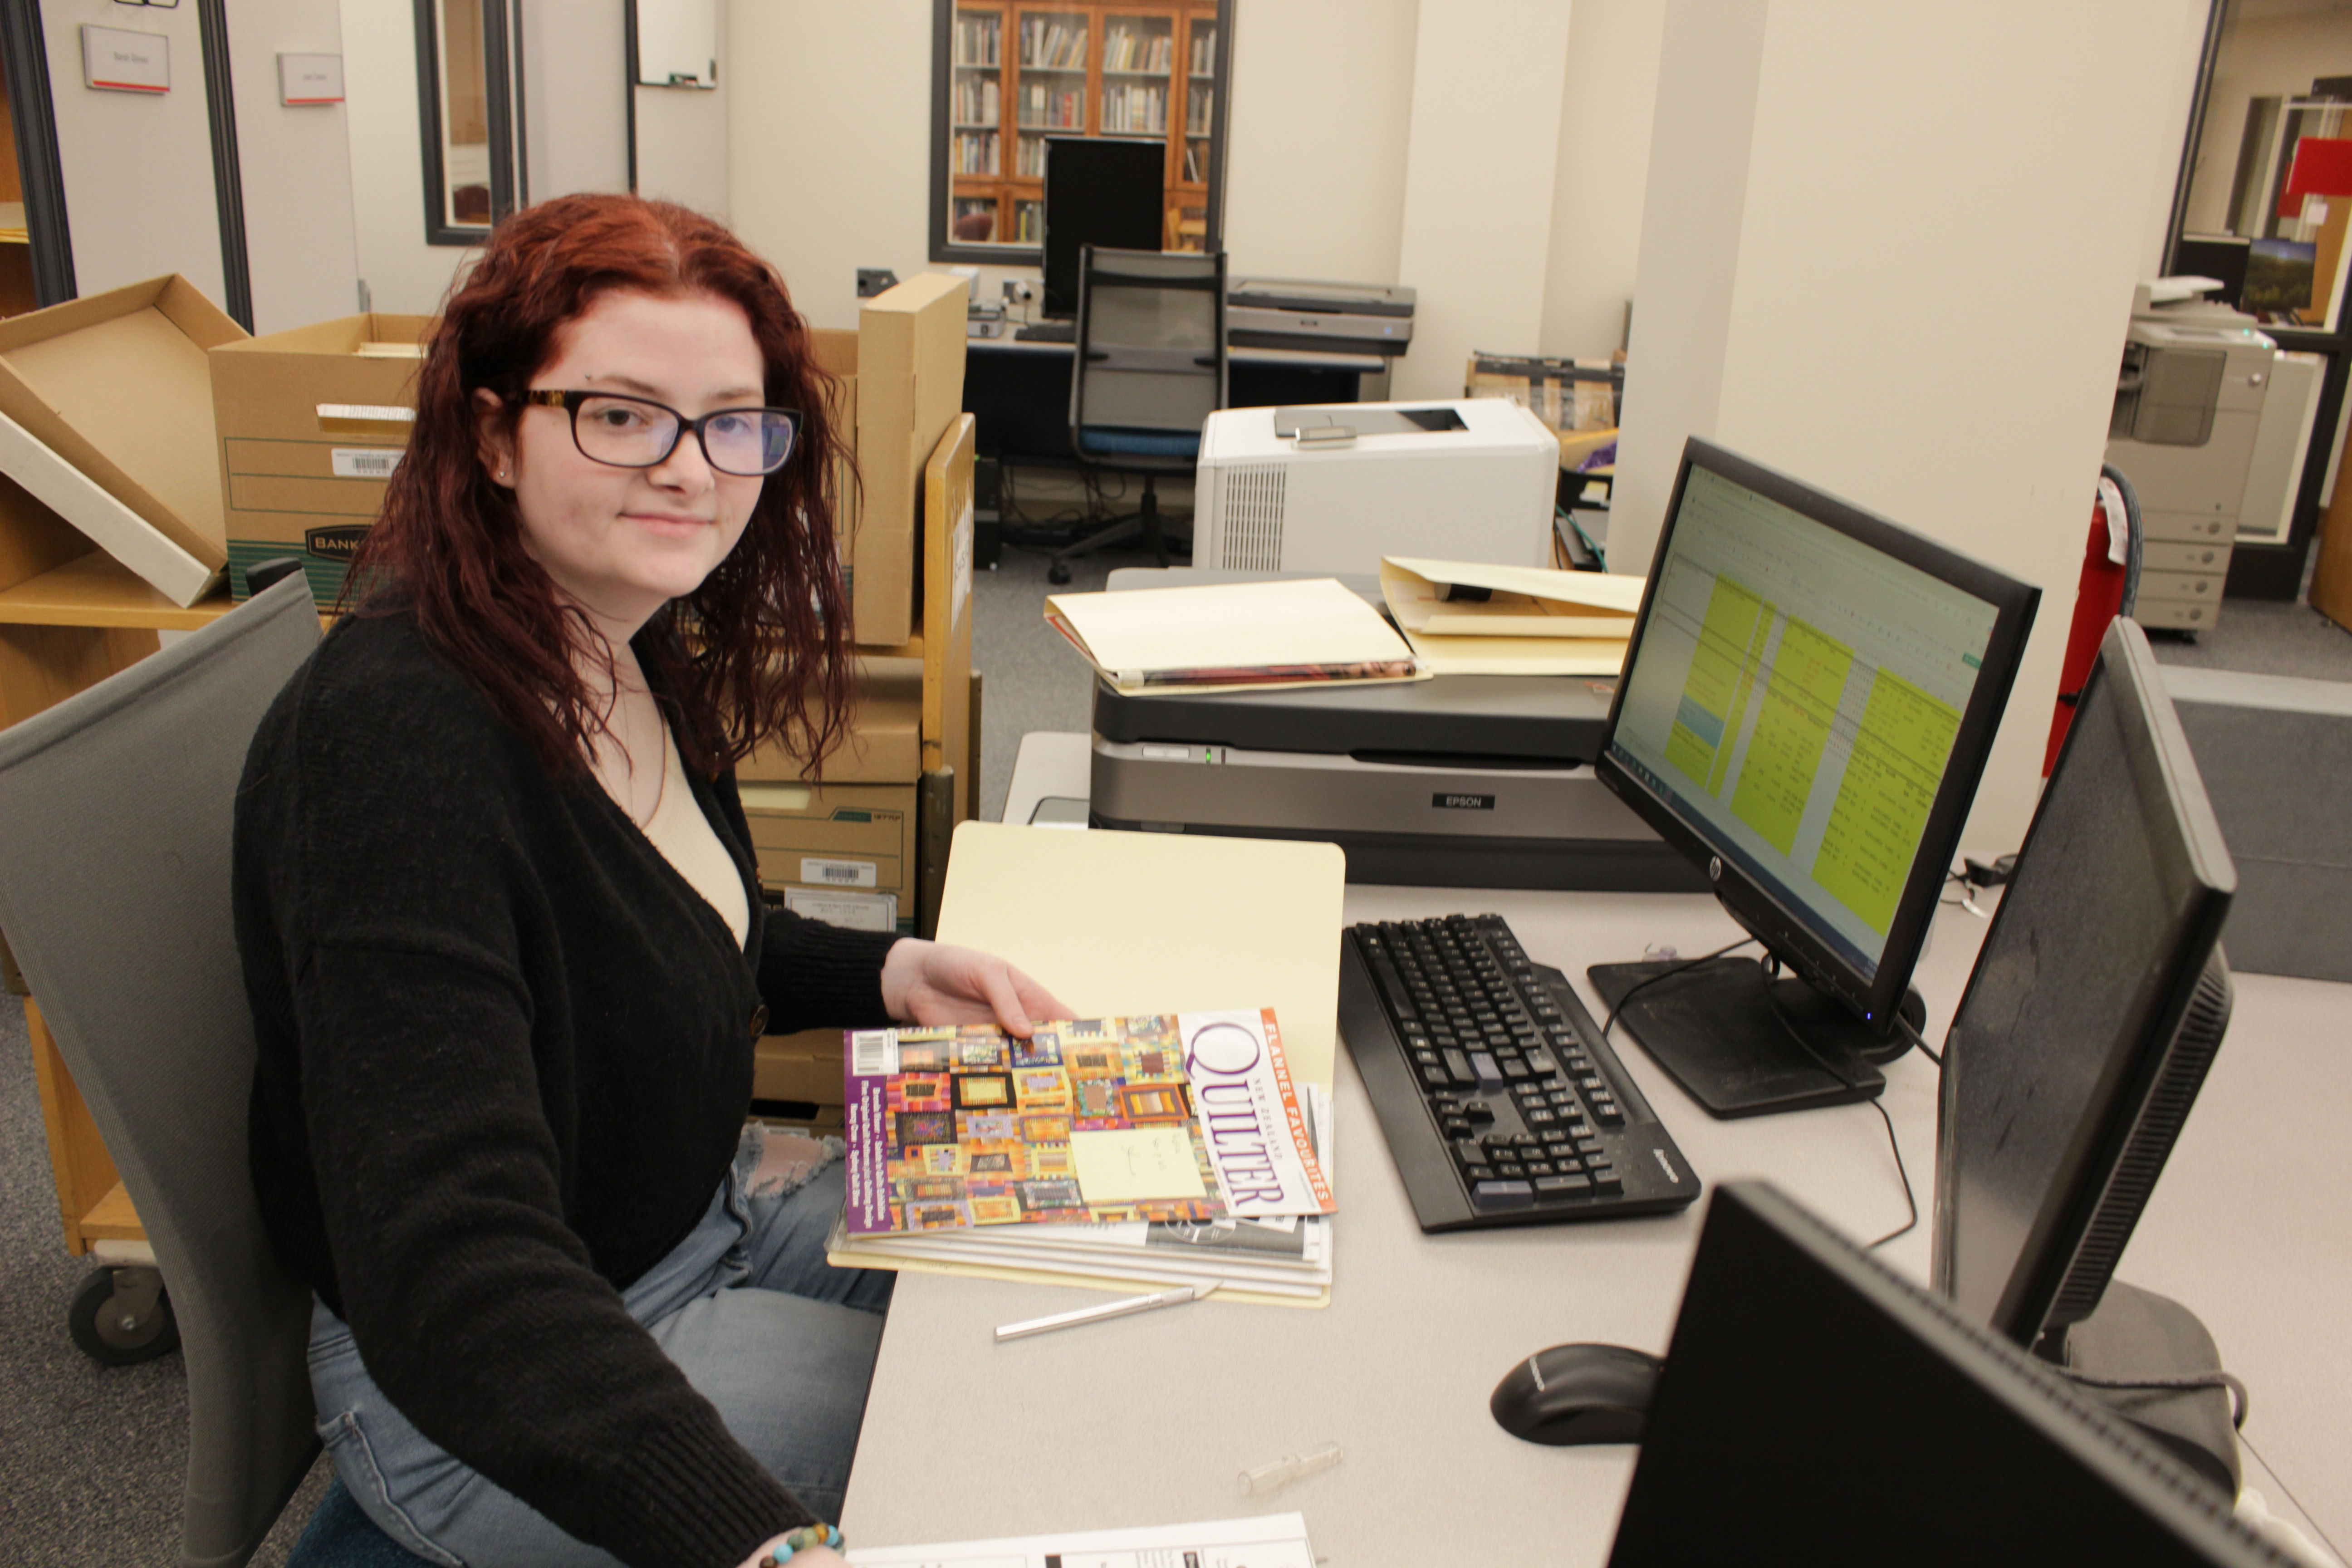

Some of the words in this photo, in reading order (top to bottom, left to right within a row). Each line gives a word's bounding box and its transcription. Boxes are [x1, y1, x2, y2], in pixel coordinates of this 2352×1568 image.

[1446, 796, 1481, 808] EPSON
[861, 1080, 869, 1096] Five
[872, 1087, 881, 1112] Brenda
[849, 1103, 858, 1124] Nancy
[860, 1096, 870, 1121] Original
[1185, 1023, 1285, 1207] QUILTER
[1252, 1078, 1266, 1102] NEW
[1261, 1107, 1283, 1161] ZEALAND
[1264, 1023, 1293, 1102] FLANNEL
[1286, 1107, 1330, 1201] FAVOURITES
[850, 1124, 858, 1142] Crow
[862, 1122, 871, 1138] Quilt
[873, 1112, 882, 1133] Visser
[850, 1150, 859, 1173] Sydney
[863, 1139, 872, 1166] Patterns
[1653, 1148, 1679, 1184] lenovo
[851, 1174, 860, 1189] Quilt
[876, 1170, 884, 1187] Quilts
[862, 1180, 873, 1205] Quilting
[876, 1188, 885, 1221] Exhibition
[864, 1205, 873, 1229] Design
